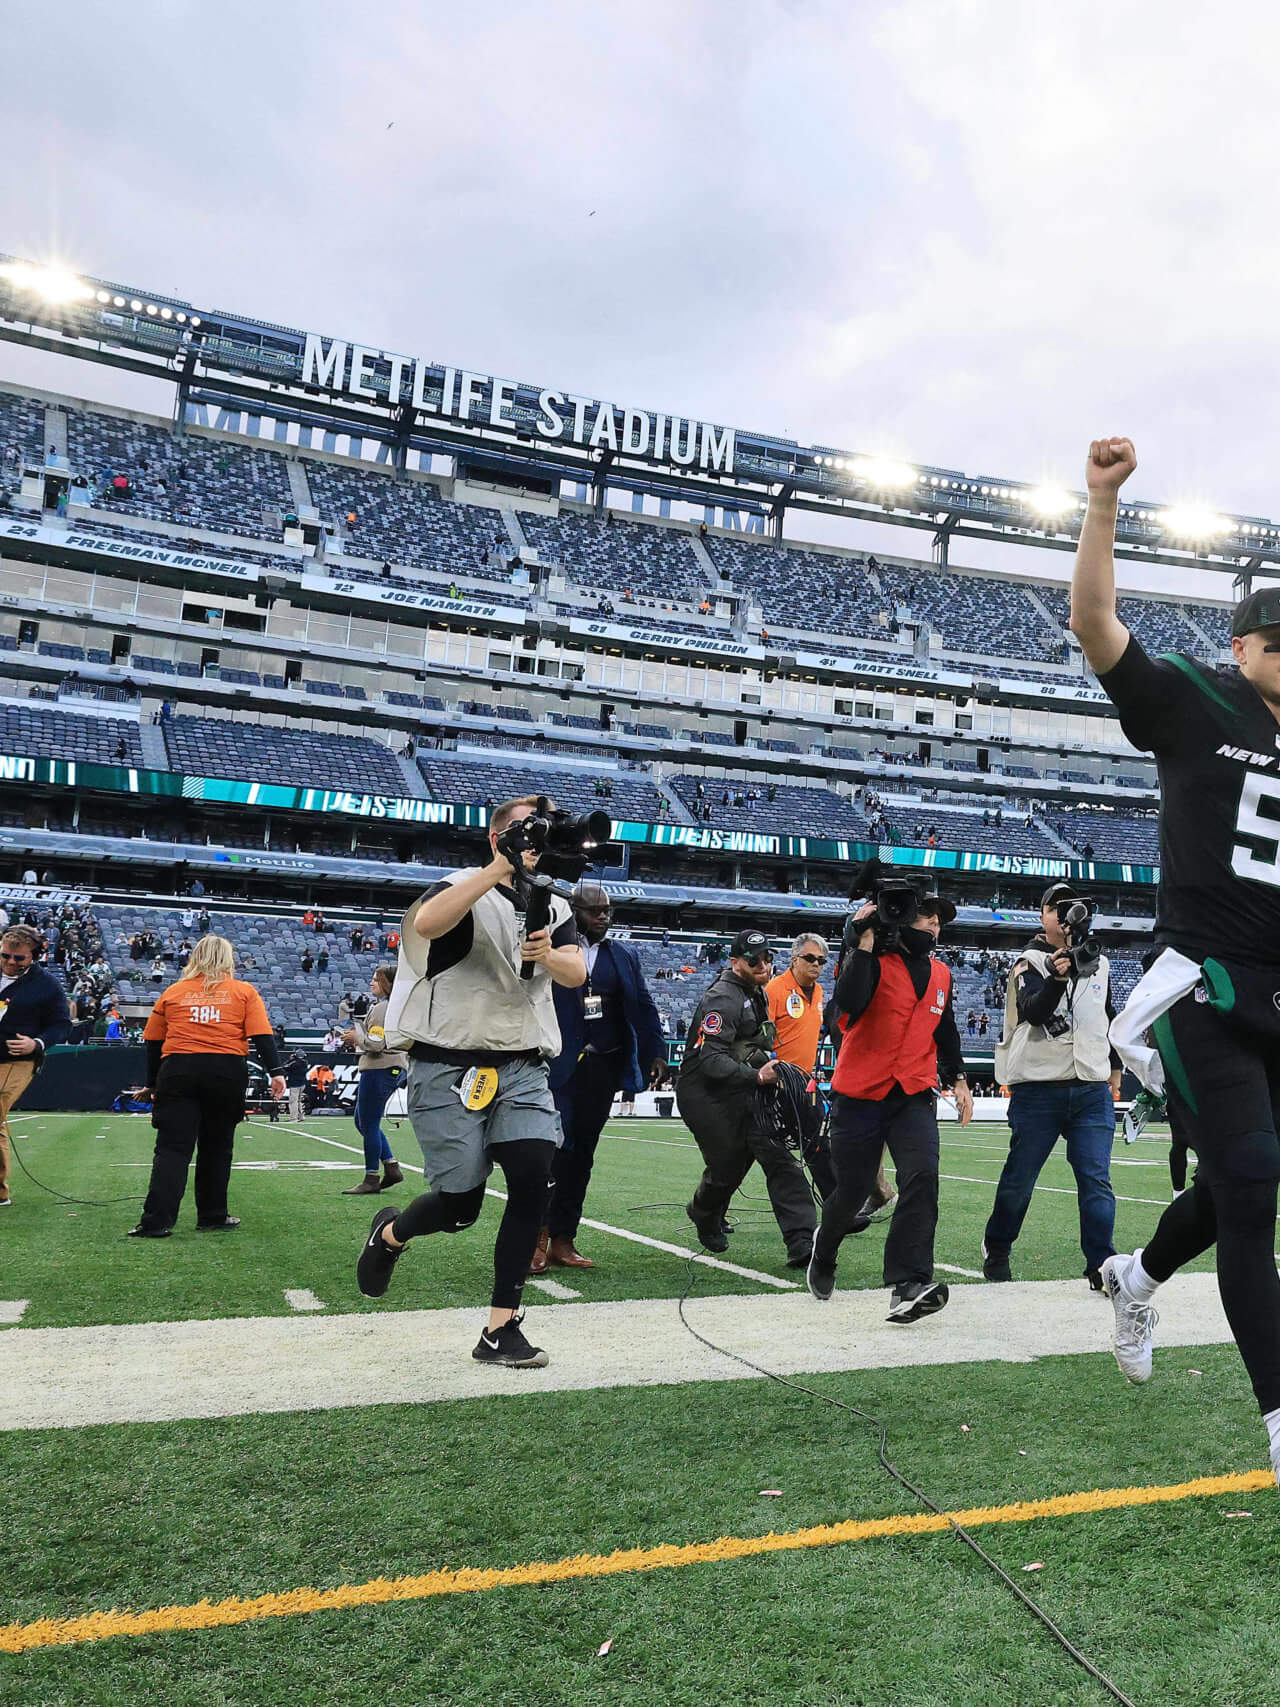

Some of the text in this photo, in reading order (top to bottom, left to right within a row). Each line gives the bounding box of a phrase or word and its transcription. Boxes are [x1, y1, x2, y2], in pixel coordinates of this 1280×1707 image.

[301, 333, 736, 473] METLIFE STADIUM
[6, 524, 248, 576] 24 FREEMAN MCNEIL
[332, 583, 496, 617] 12 JOE NAMATH
[587, 623, 749, 655] 81 GERRY PHILBIN
[853, 662, 893, 677] MATT
[894, 667, 939, 682] SNELL
[1040, 686, 1056, 695] 88
[1074, 691, 1089, 699] AL
[1216, 744, 1276, 767] NEW
[328, 790, 389, 818] JETS
[675, 826, 725, 850] JETS
[245, 855, 316, 870] MetLife
[981, 853, 1023, 874] JETS
[0, 888, 93, 903] ORK JETS
[601, 885, 646, 896] DIUM
[188, 1005, 221, 1024] 384
[475, 1074, 488, 1094] WEEK
